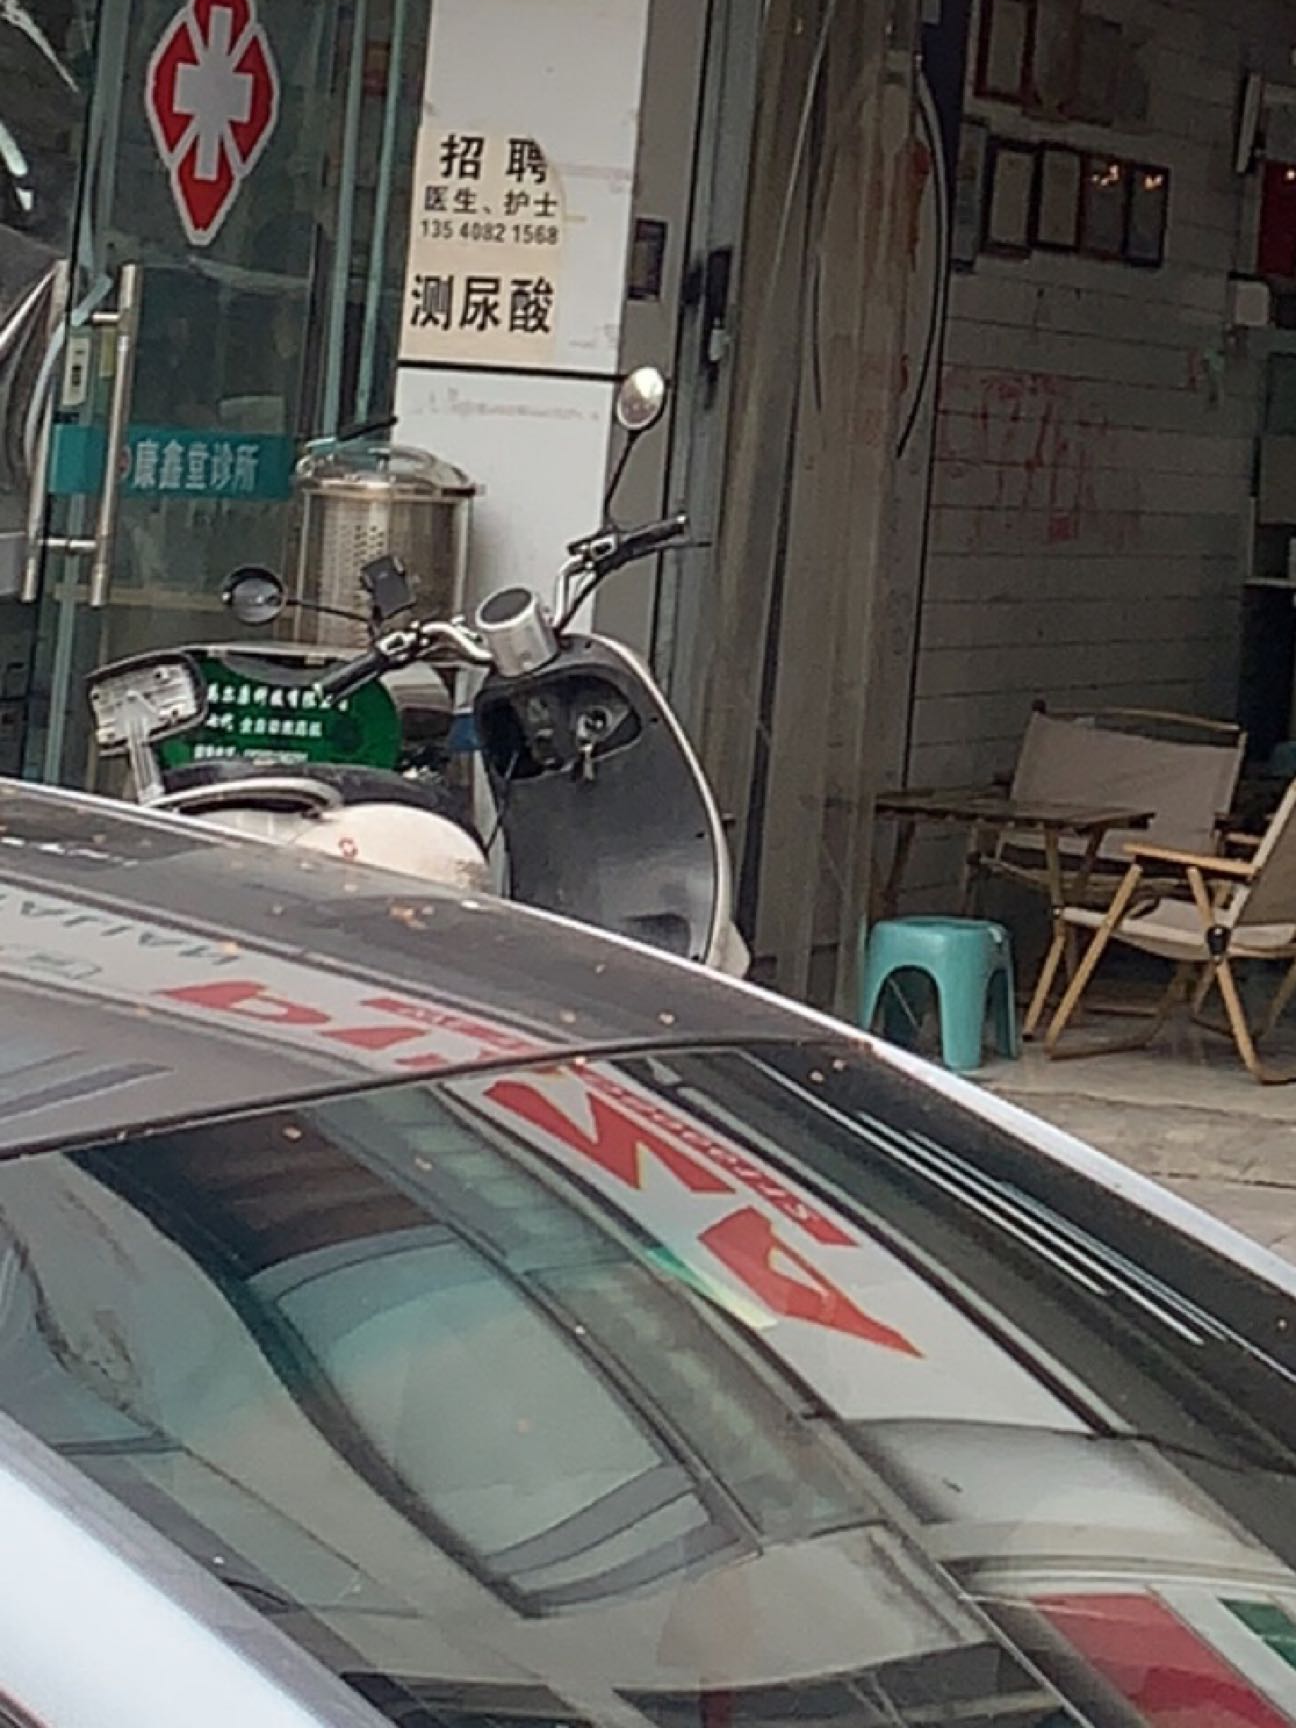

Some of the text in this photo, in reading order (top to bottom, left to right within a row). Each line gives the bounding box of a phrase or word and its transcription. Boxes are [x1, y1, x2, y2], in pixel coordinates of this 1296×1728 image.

[440, 133, 547, 184] 招聘
[410, 275, 553, 333] 测尿酸
